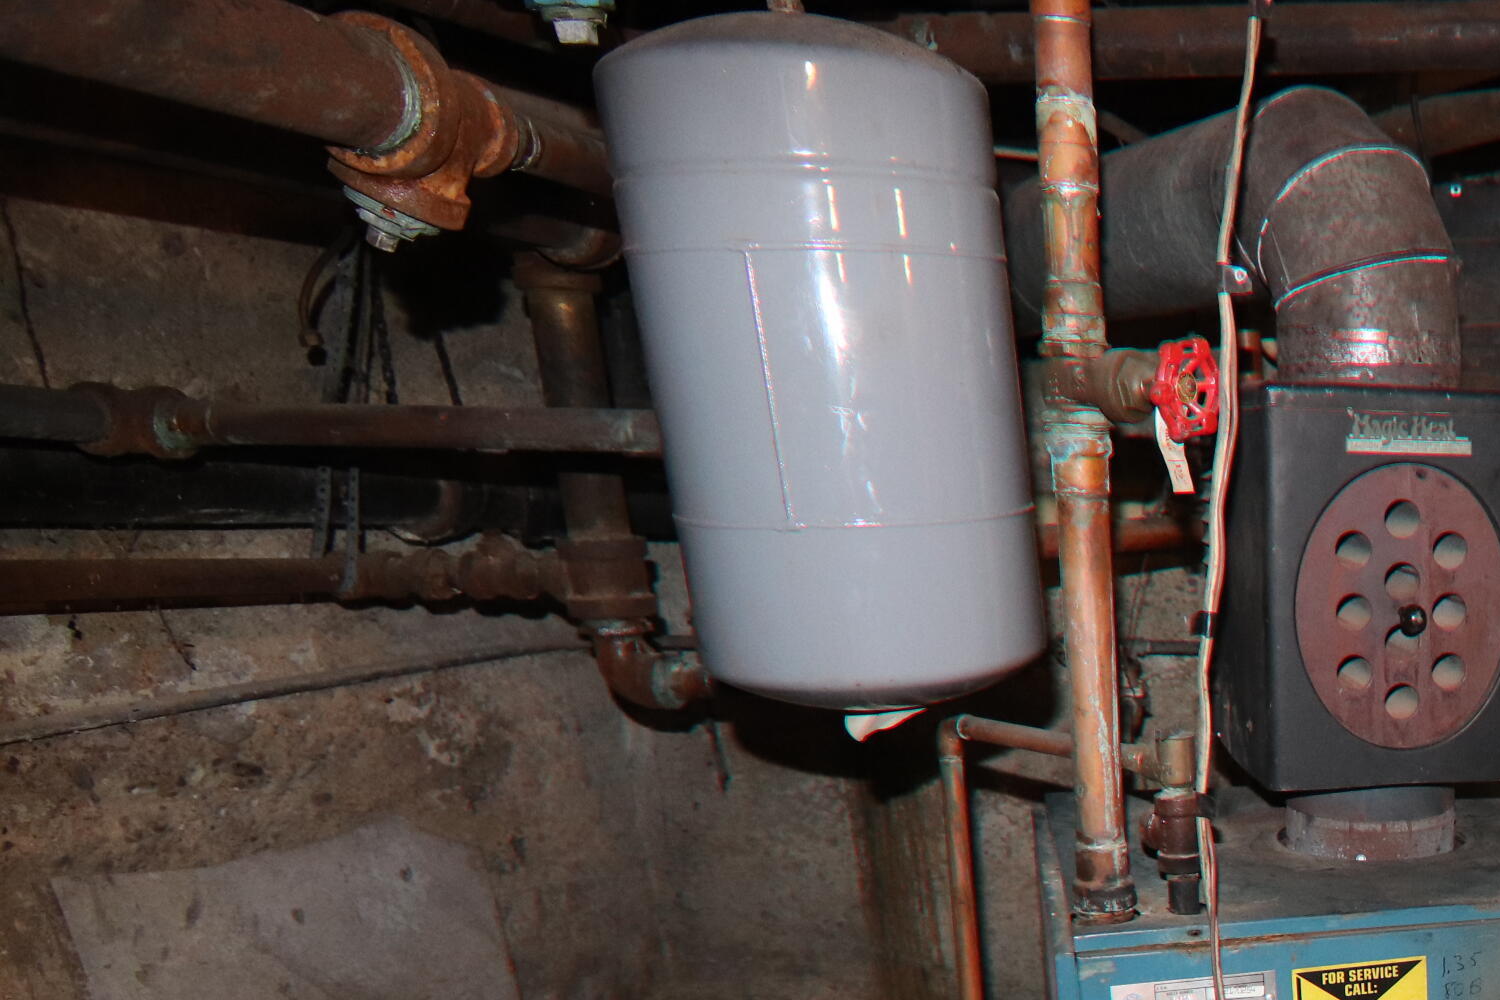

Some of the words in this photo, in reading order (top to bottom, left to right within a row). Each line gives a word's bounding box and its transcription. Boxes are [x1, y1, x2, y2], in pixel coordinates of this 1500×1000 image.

[1321, 971, 1345, 985] FOR
[1348, 965, 1399, 982] SERVICE
[1344, 982, 1378, 997] CALL:
